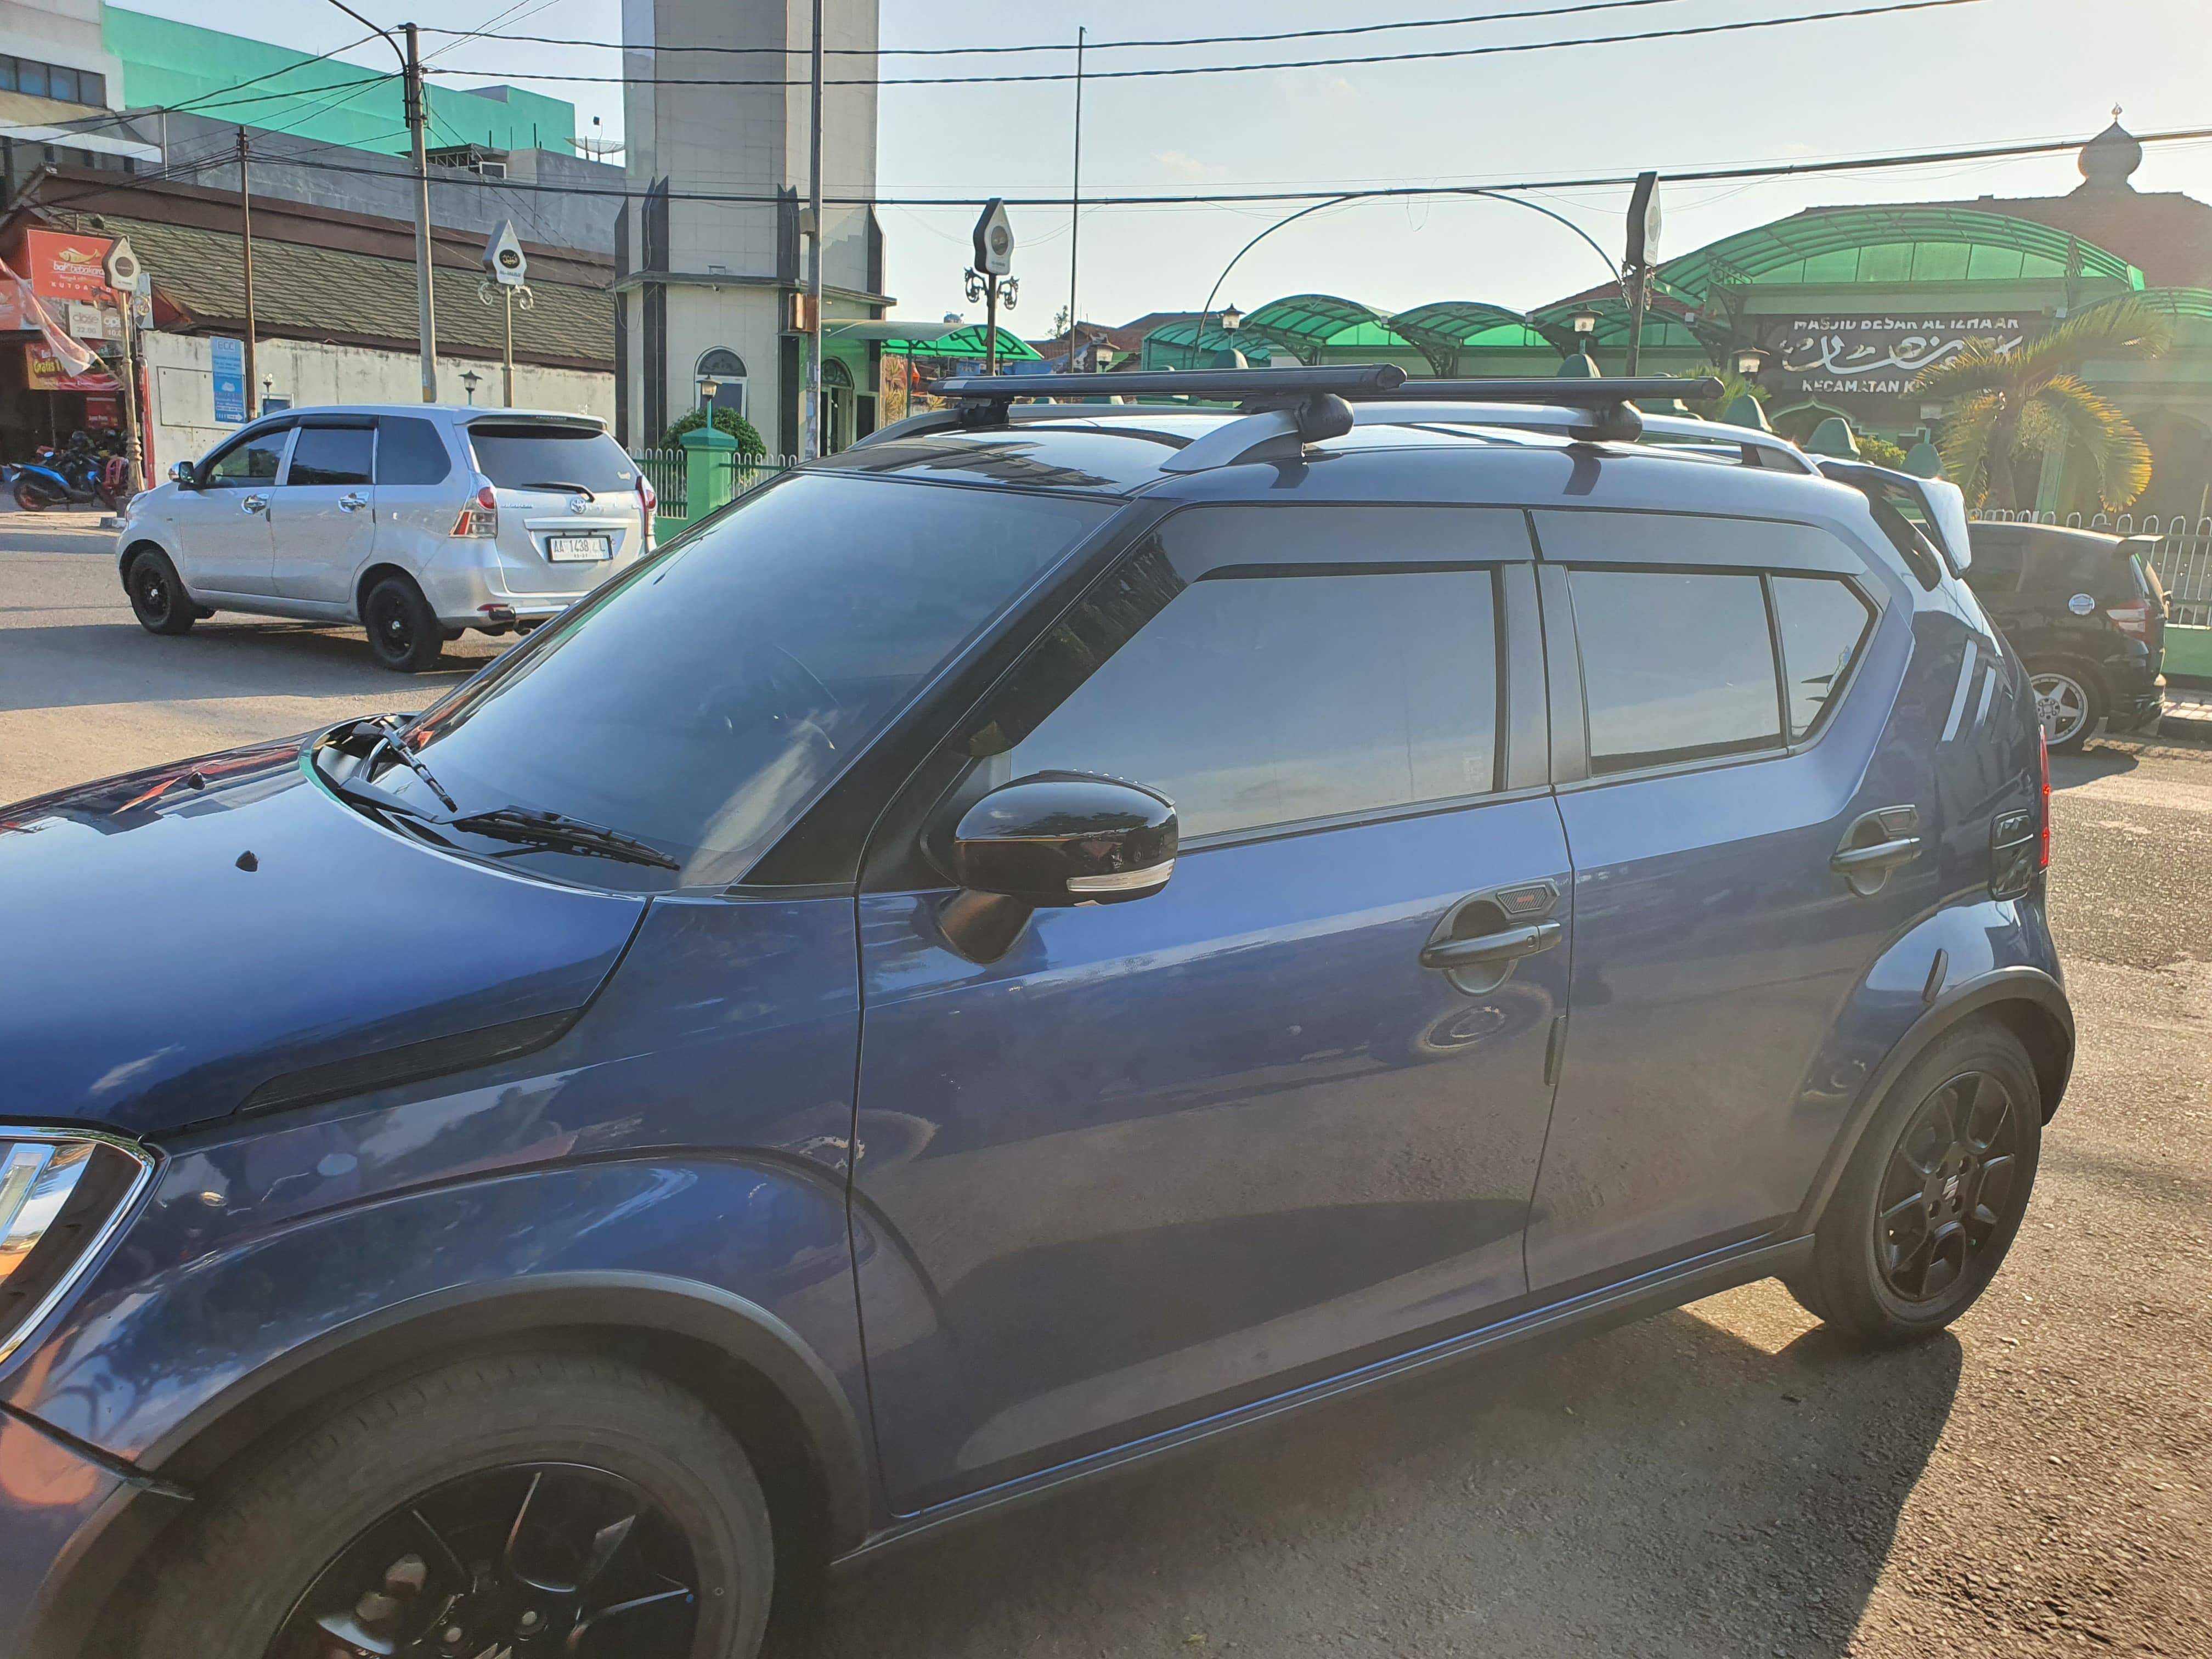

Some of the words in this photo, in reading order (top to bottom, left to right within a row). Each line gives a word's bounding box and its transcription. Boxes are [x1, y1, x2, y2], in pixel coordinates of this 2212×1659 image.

[51, 281, 111, 293] KUTOAO
[72, 313, 99, 324] close
[1794, 317, 1857, 330] MASJID
[1861, 317, 1918, 330] BESAR
[1922, 320, 1945, 330] AL
[1802, 379, 1900, 393] KECAMATAN
[554, 539, 565, 552] AA
[569, 539, 589, 552] 1438
